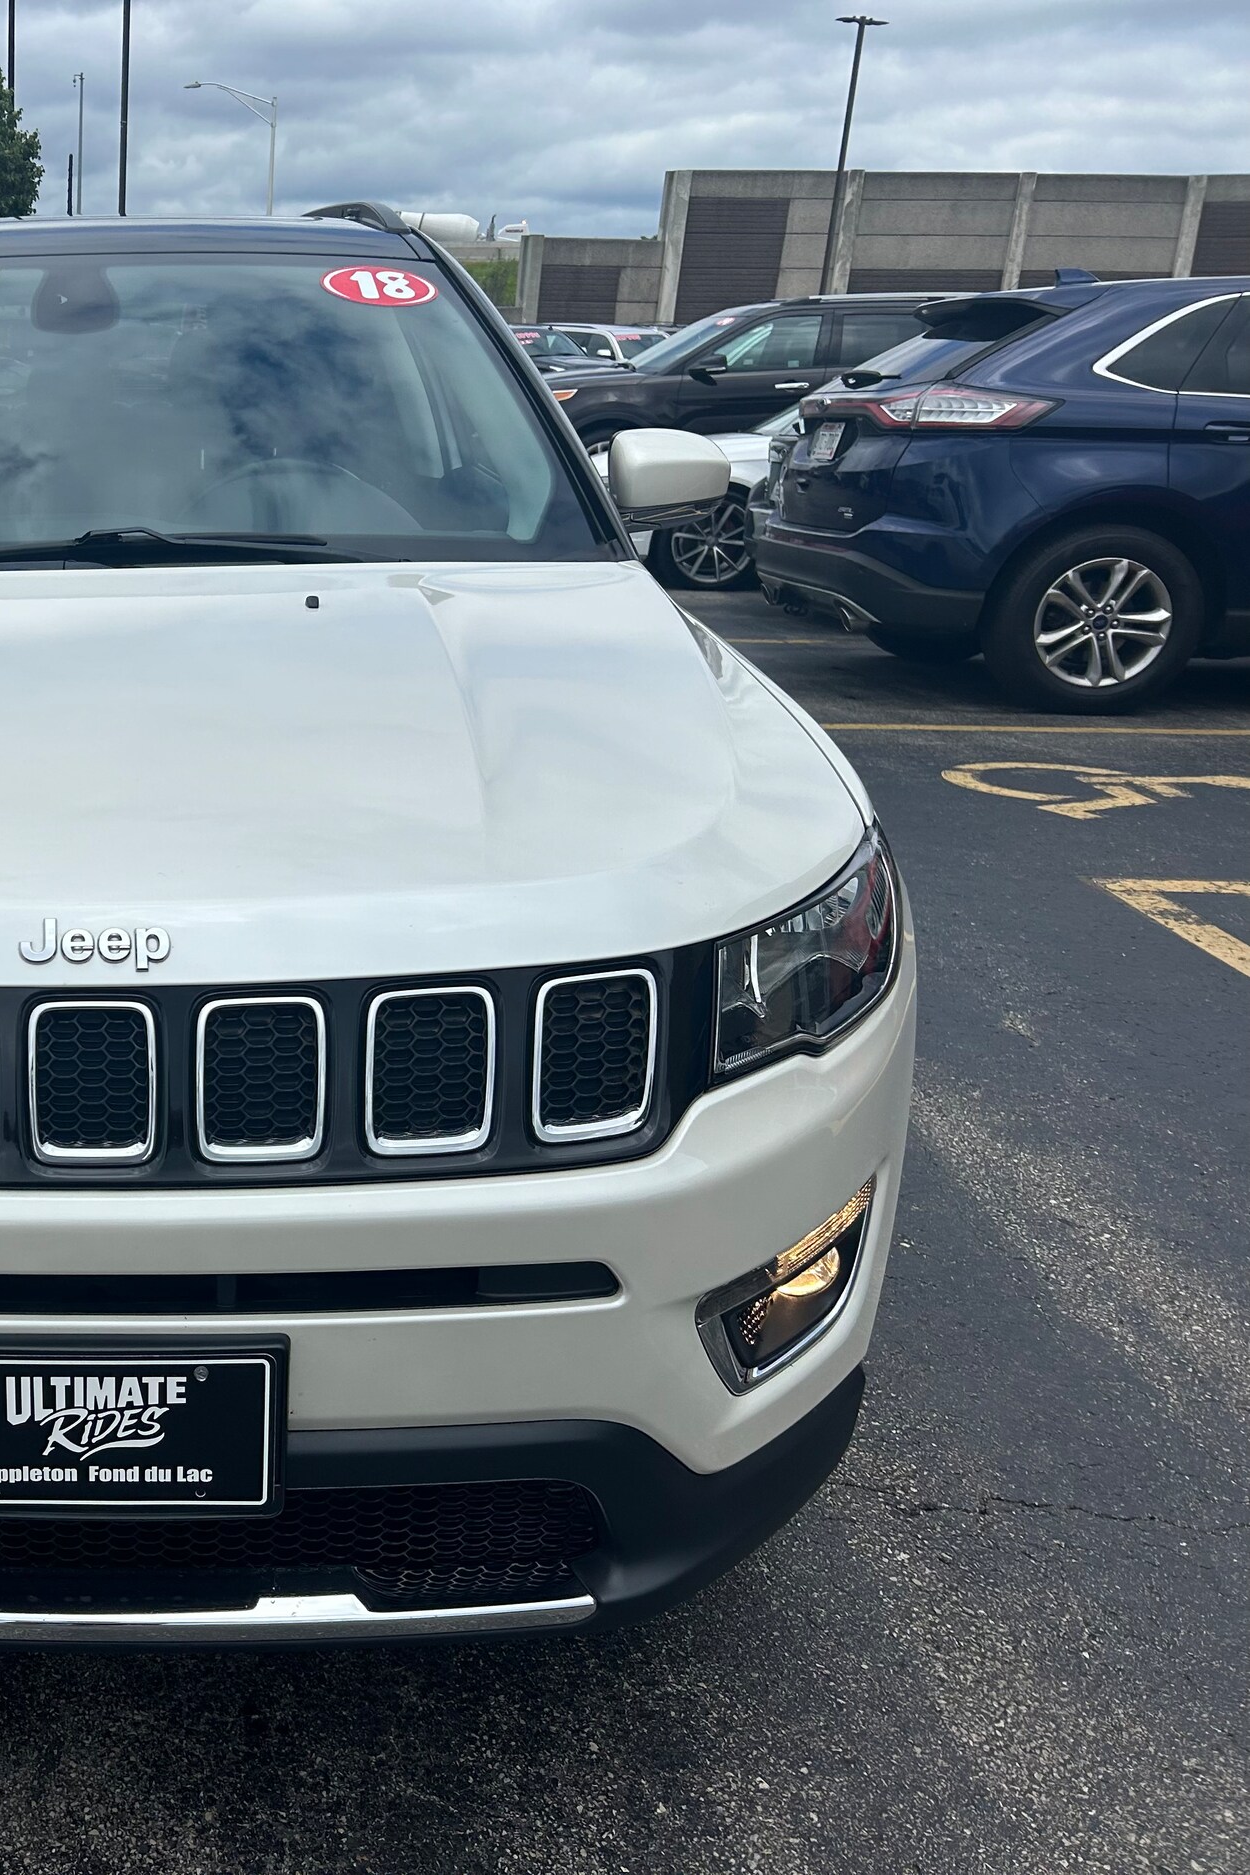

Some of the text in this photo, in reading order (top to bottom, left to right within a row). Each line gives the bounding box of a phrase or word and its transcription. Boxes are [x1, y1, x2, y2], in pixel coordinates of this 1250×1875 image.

[350, 270, 416, 300] 18
[18, 917, 171, 973] Jeep
[5, 1376, 188, 1426] ULTIMATE
[88, 1466, 140, 1483] Fond
[144, 1466, 172, 1483] du
[176, 1466, 213, 1483] Lac
